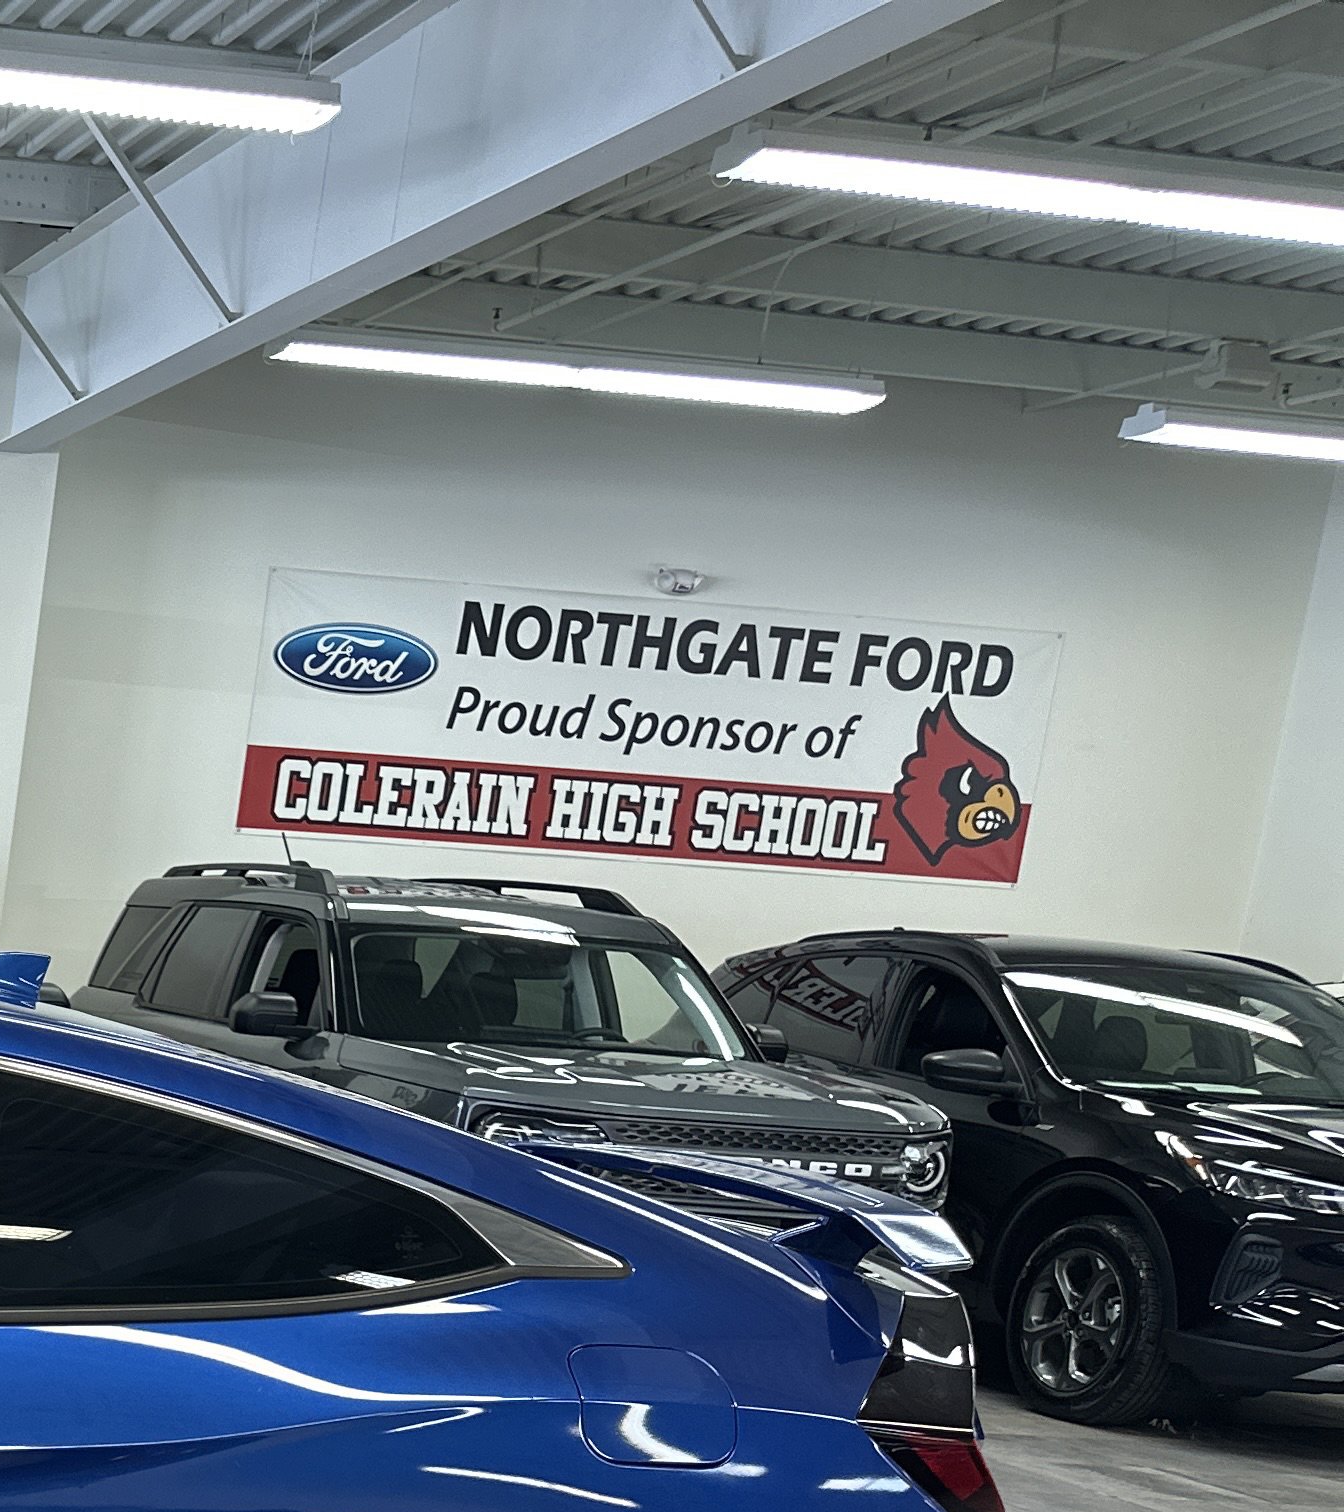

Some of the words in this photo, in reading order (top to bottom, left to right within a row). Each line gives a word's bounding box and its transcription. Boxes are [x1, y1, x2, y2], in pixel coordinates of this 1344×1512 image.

[302, 632, 407, 686] Ford
[455, 601, 841, 685] NORTHGATE
[849, 635, 1015, 698] FORD
[446, 686, 596, 741] Proud
[599, 698, 799, 756] Sponsor
[804, 714, 863, 760] of
[273, 758, 535, 837] COLERAIN
[545, 780, 676, 847] HIGH
[690, 793, 888, 864] SCHOOL
